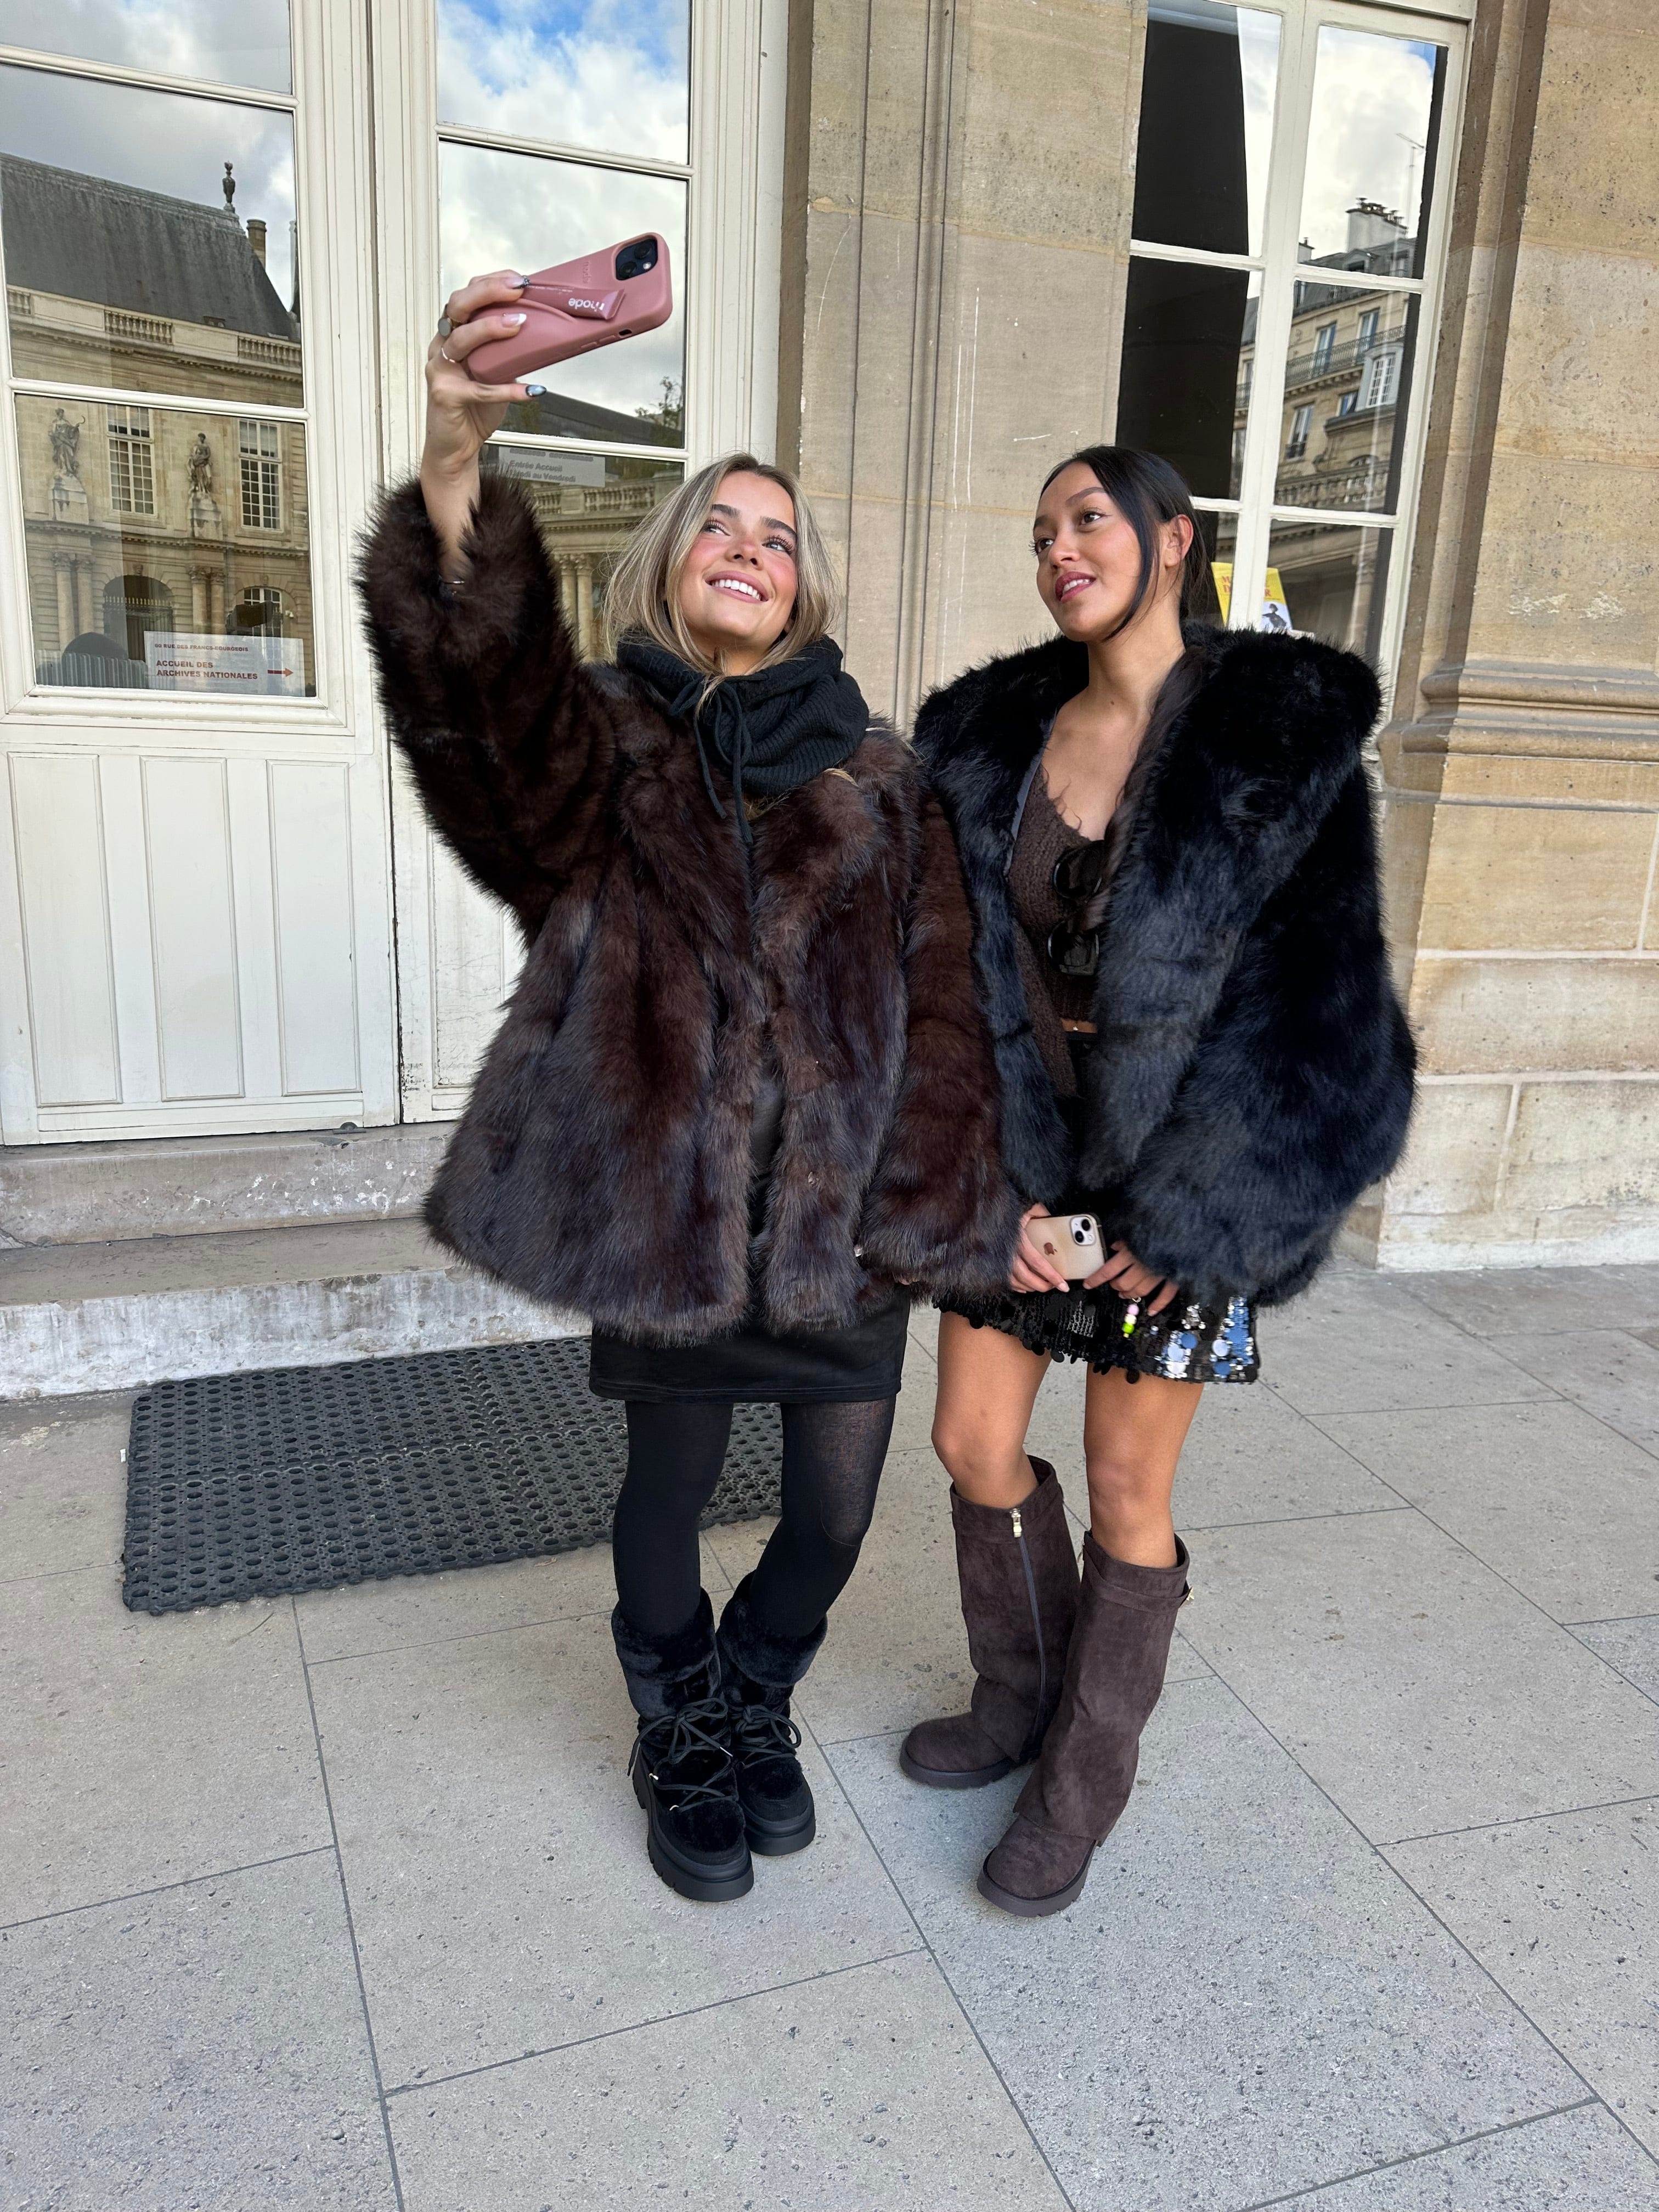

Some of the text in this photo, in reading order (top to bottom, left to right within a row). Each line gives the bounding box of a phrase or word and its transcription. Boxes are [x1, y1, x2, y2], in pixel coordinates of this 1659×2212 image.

[568, 297, 605, 312] rhode
[543, 473, 576, 482] Vendredi
[204, 672, 258, 680] NATIONALES
